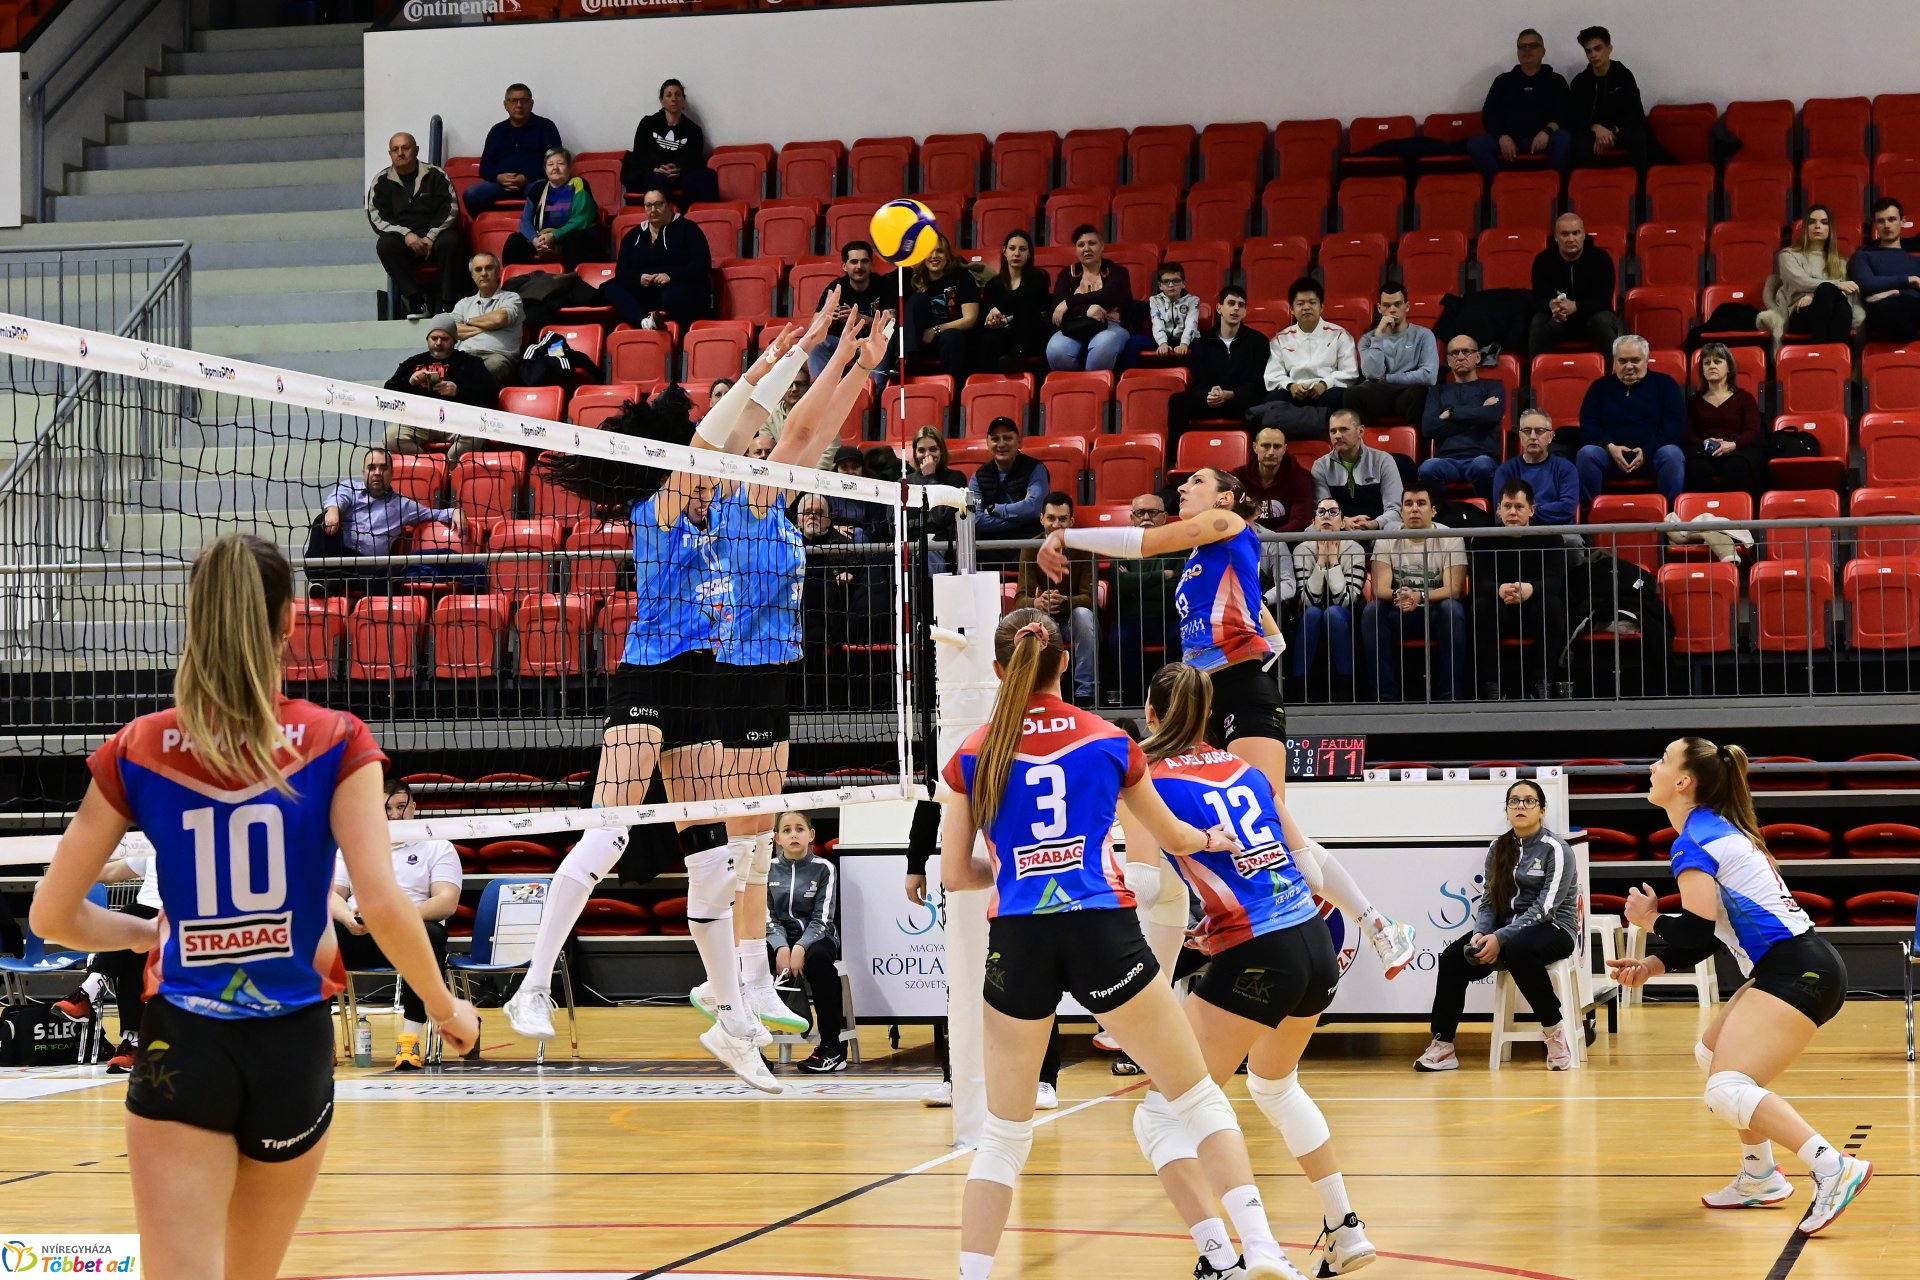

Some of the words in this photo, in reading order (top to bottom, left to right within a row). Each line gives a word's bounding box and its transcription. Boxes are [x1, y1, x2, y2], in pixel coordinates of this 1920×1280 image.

[403, 0, 505, 22] Continental
[1022, 716, 1077, 735] ÖLDI
[1294, 749, 1300, 757] T
[1320, 739, 1364, 749] FATUM
[1292, 766, 1300, 774] V
[1322, 750, 1357, 776] 11
[1025, 763, 1067, 840] 3
[1203, 784, 1275, 849] 12
[182, 803, 287, 917] 10
[1018, 845, 1084, 871] STRABAG
[185, 926, 288, 952] STRABAG
[909, 943, 946, 953] MAGYA
[872, 953, 945, 976] RÖPLA
[904, 980, 947, 989] SZÖVETS
[33, 1021, 78, 1040] SELEC
